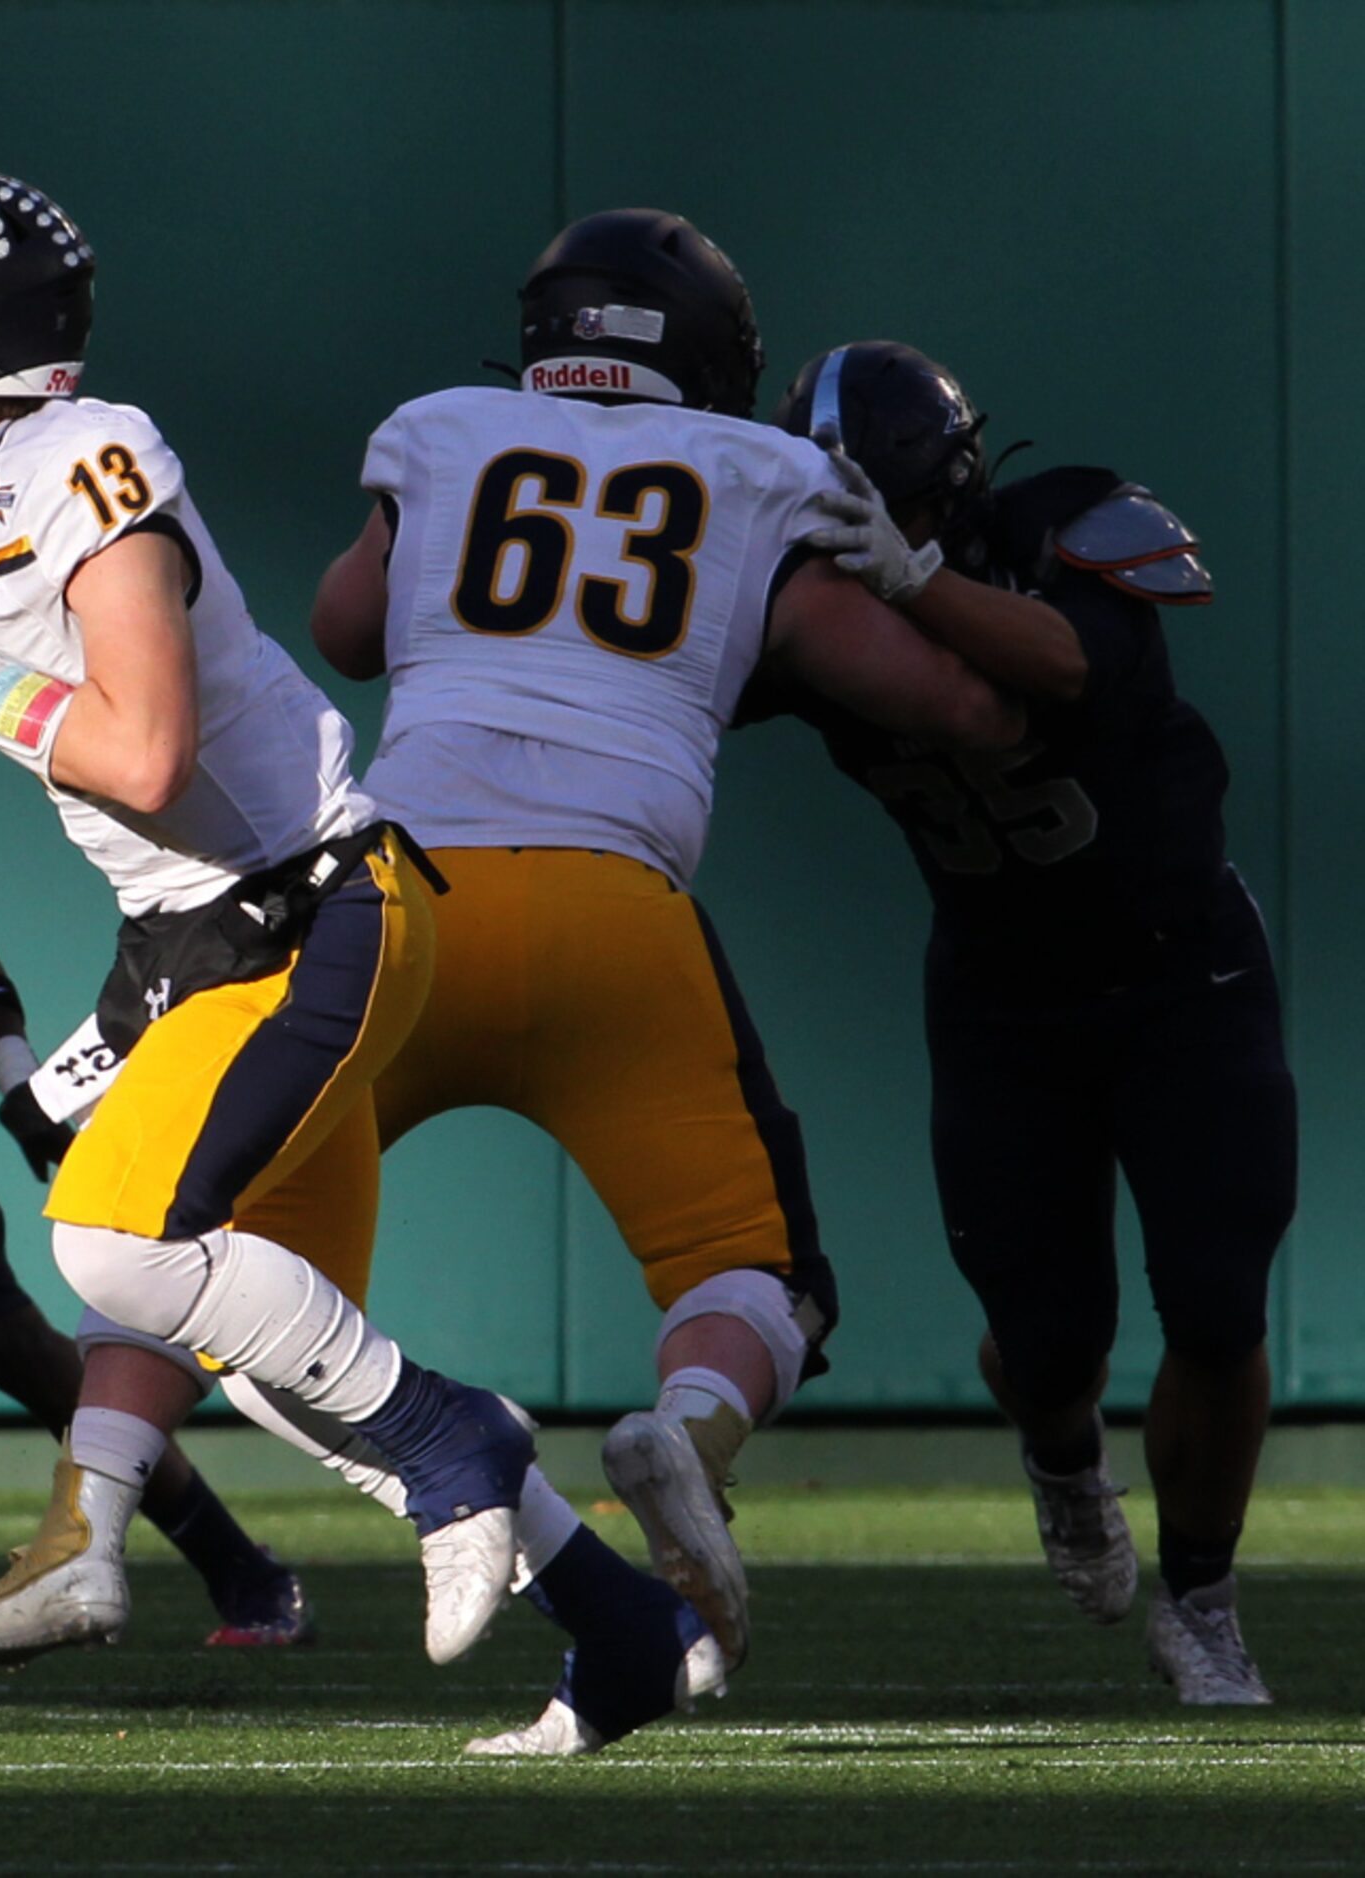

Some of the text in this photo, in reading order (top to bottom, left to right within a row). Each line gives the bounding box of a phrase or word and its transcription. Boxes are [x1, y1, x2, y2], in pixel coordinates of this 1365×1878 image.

[531, 364, 631, 392] Riddell
[65, 442, 154, 533] 13
[449, 446, 711, 661] 63
[865, 738, 1100, 875] 35
